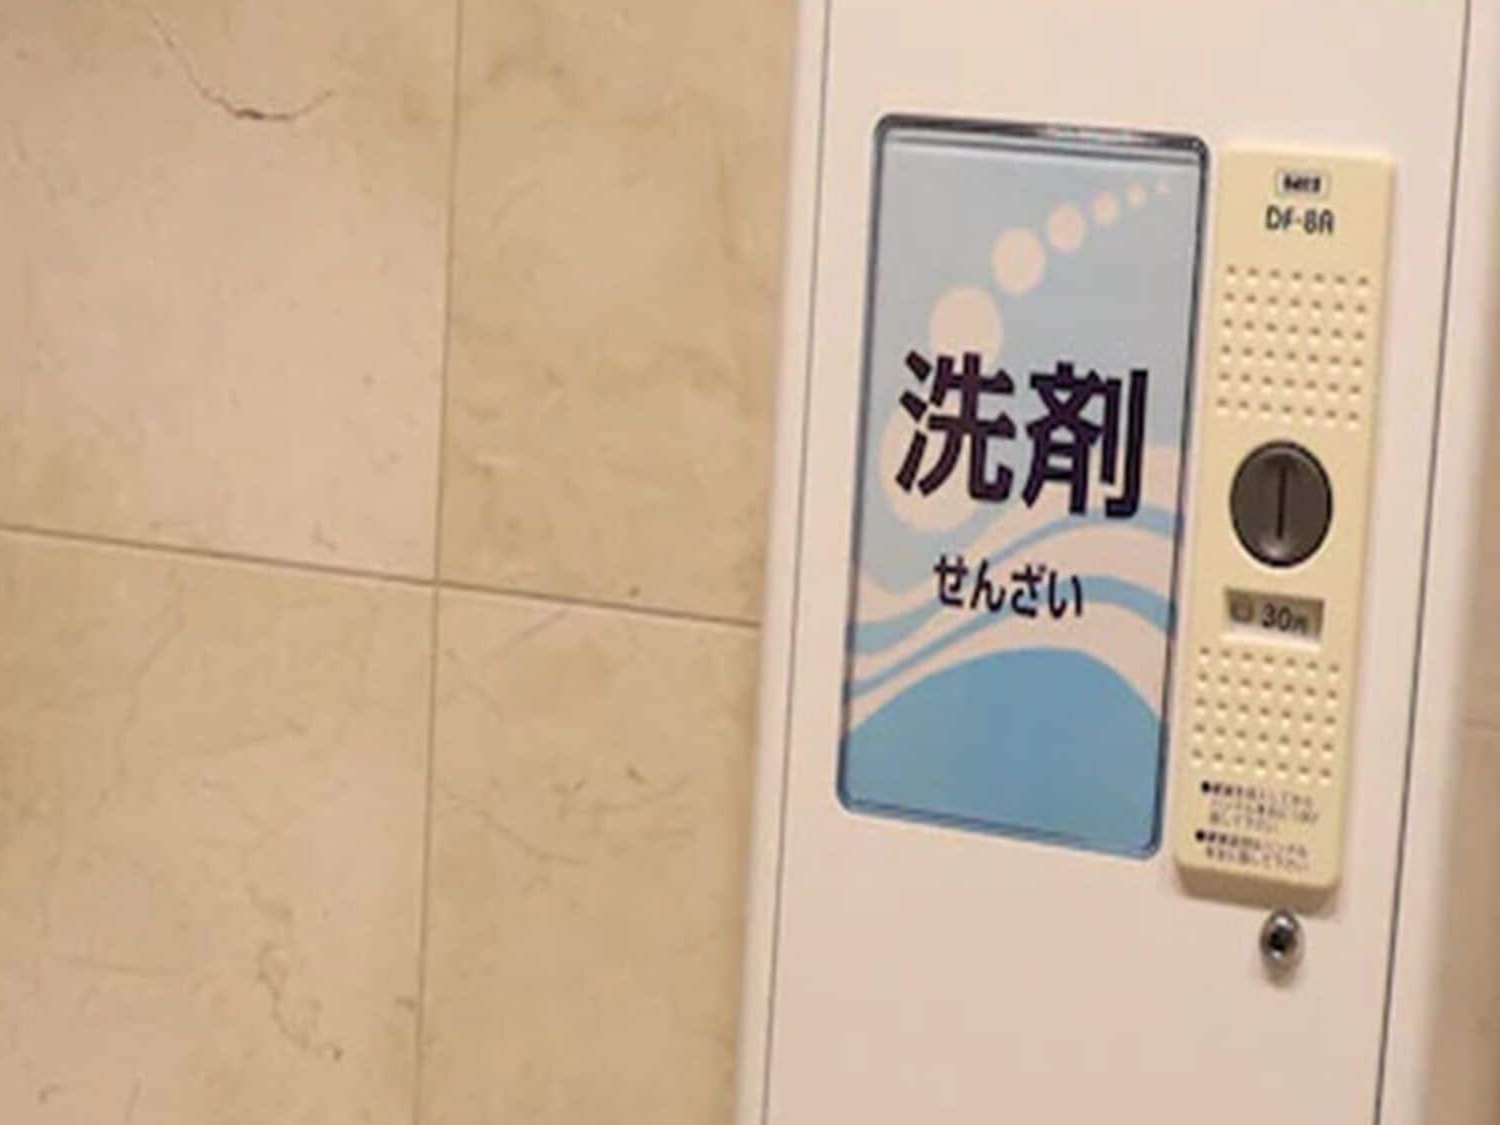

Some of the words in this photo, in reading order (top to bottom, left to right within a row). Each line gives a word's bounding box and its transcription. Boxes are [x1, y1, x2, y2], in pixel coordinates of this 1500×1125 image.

[895, 350, 1148, 518] 洗剤
[934, 554, 1082, 619] せんざい
